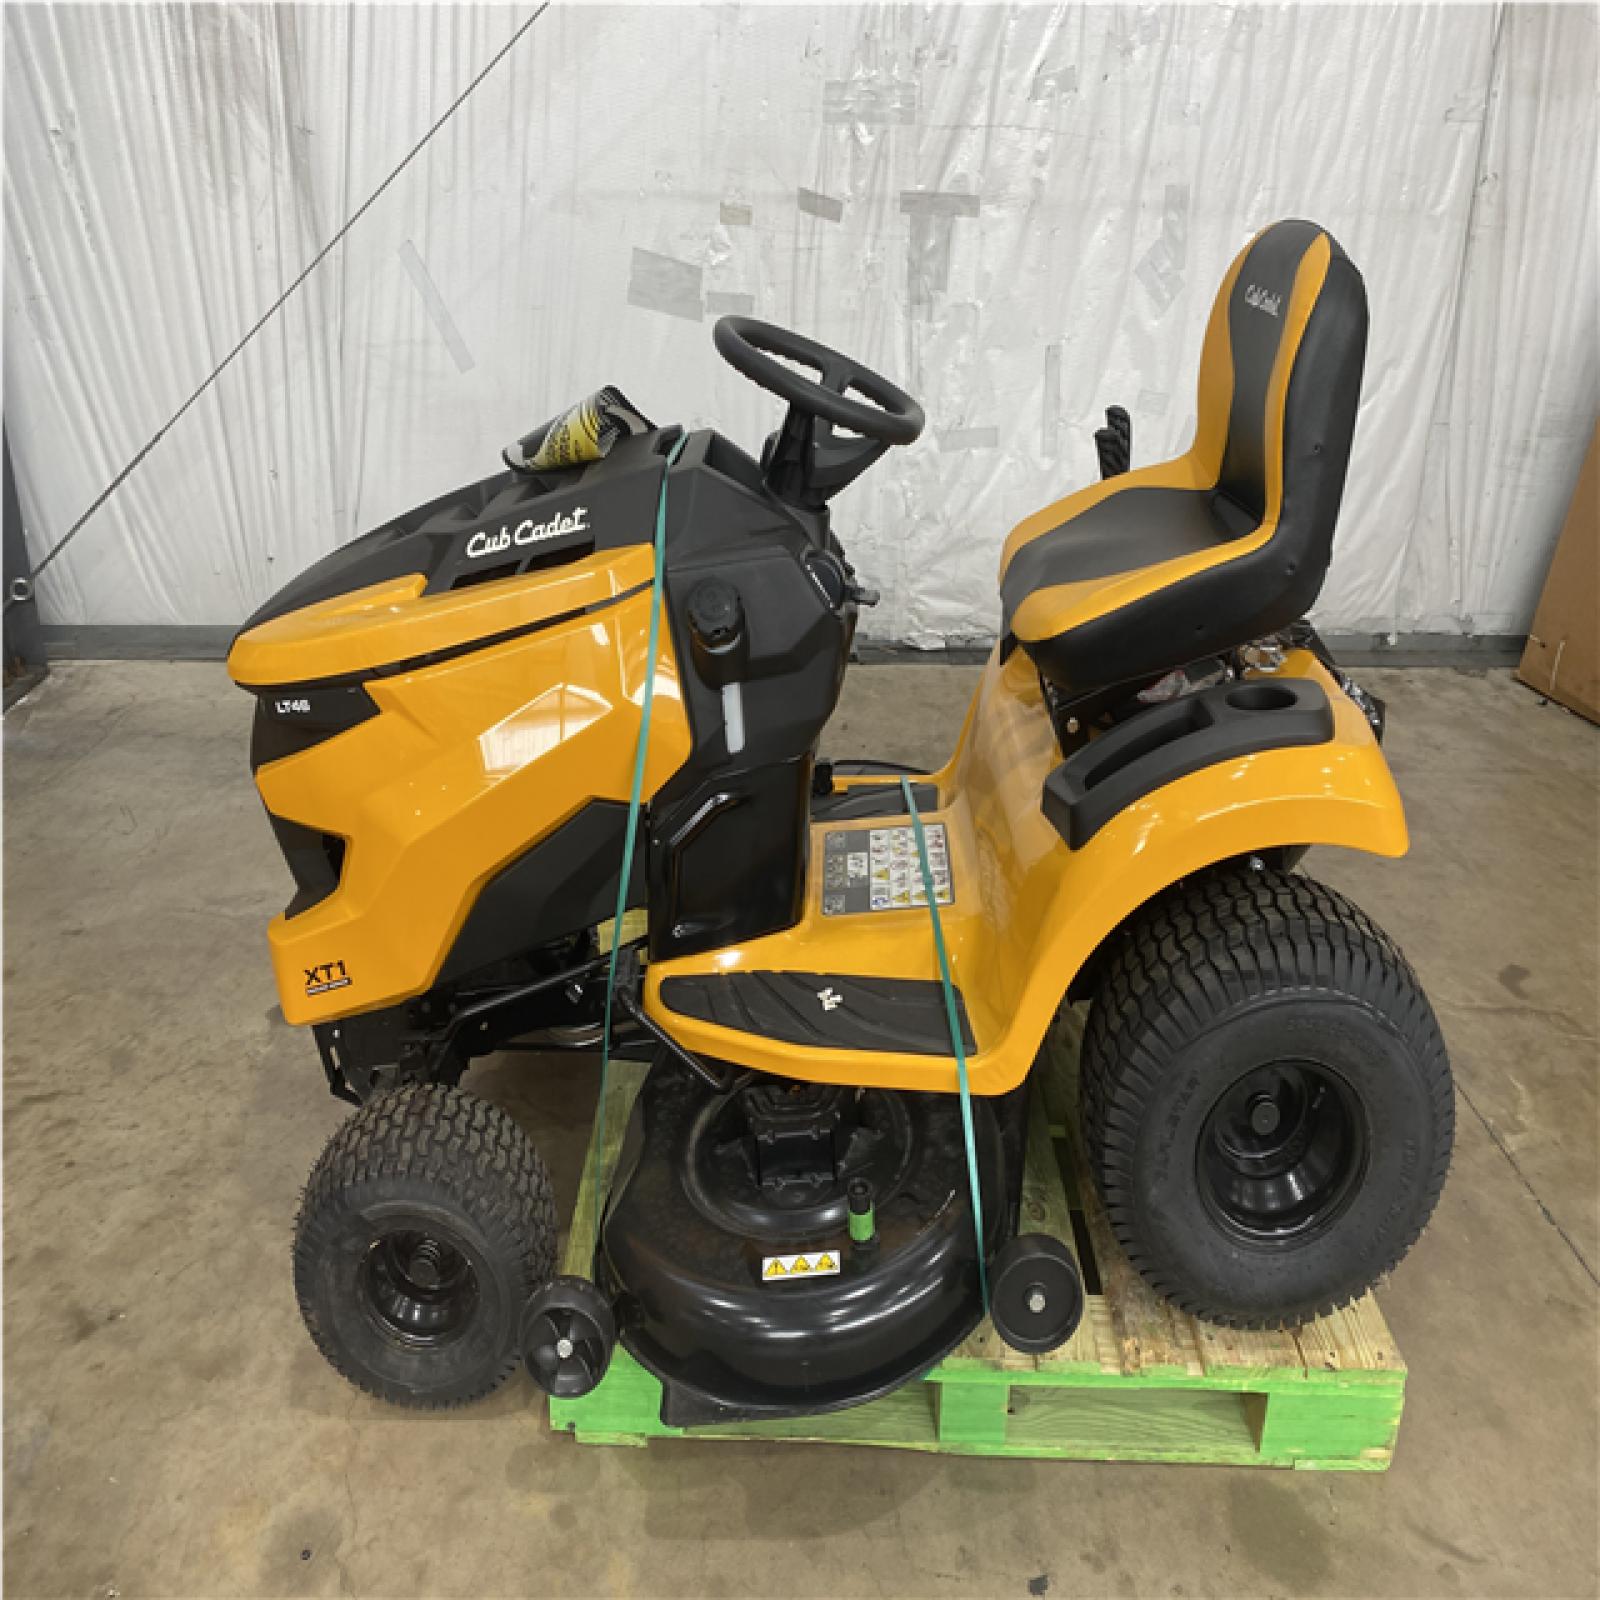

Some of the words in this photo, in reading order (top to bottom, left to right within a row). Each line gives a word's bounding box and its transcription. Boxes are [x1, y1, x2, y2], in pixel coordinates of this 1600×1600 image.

[466, 526, 511, 558] Cub
[514, 507, 588, 546] Cadet
[304, 959, 346, 986] XT1
